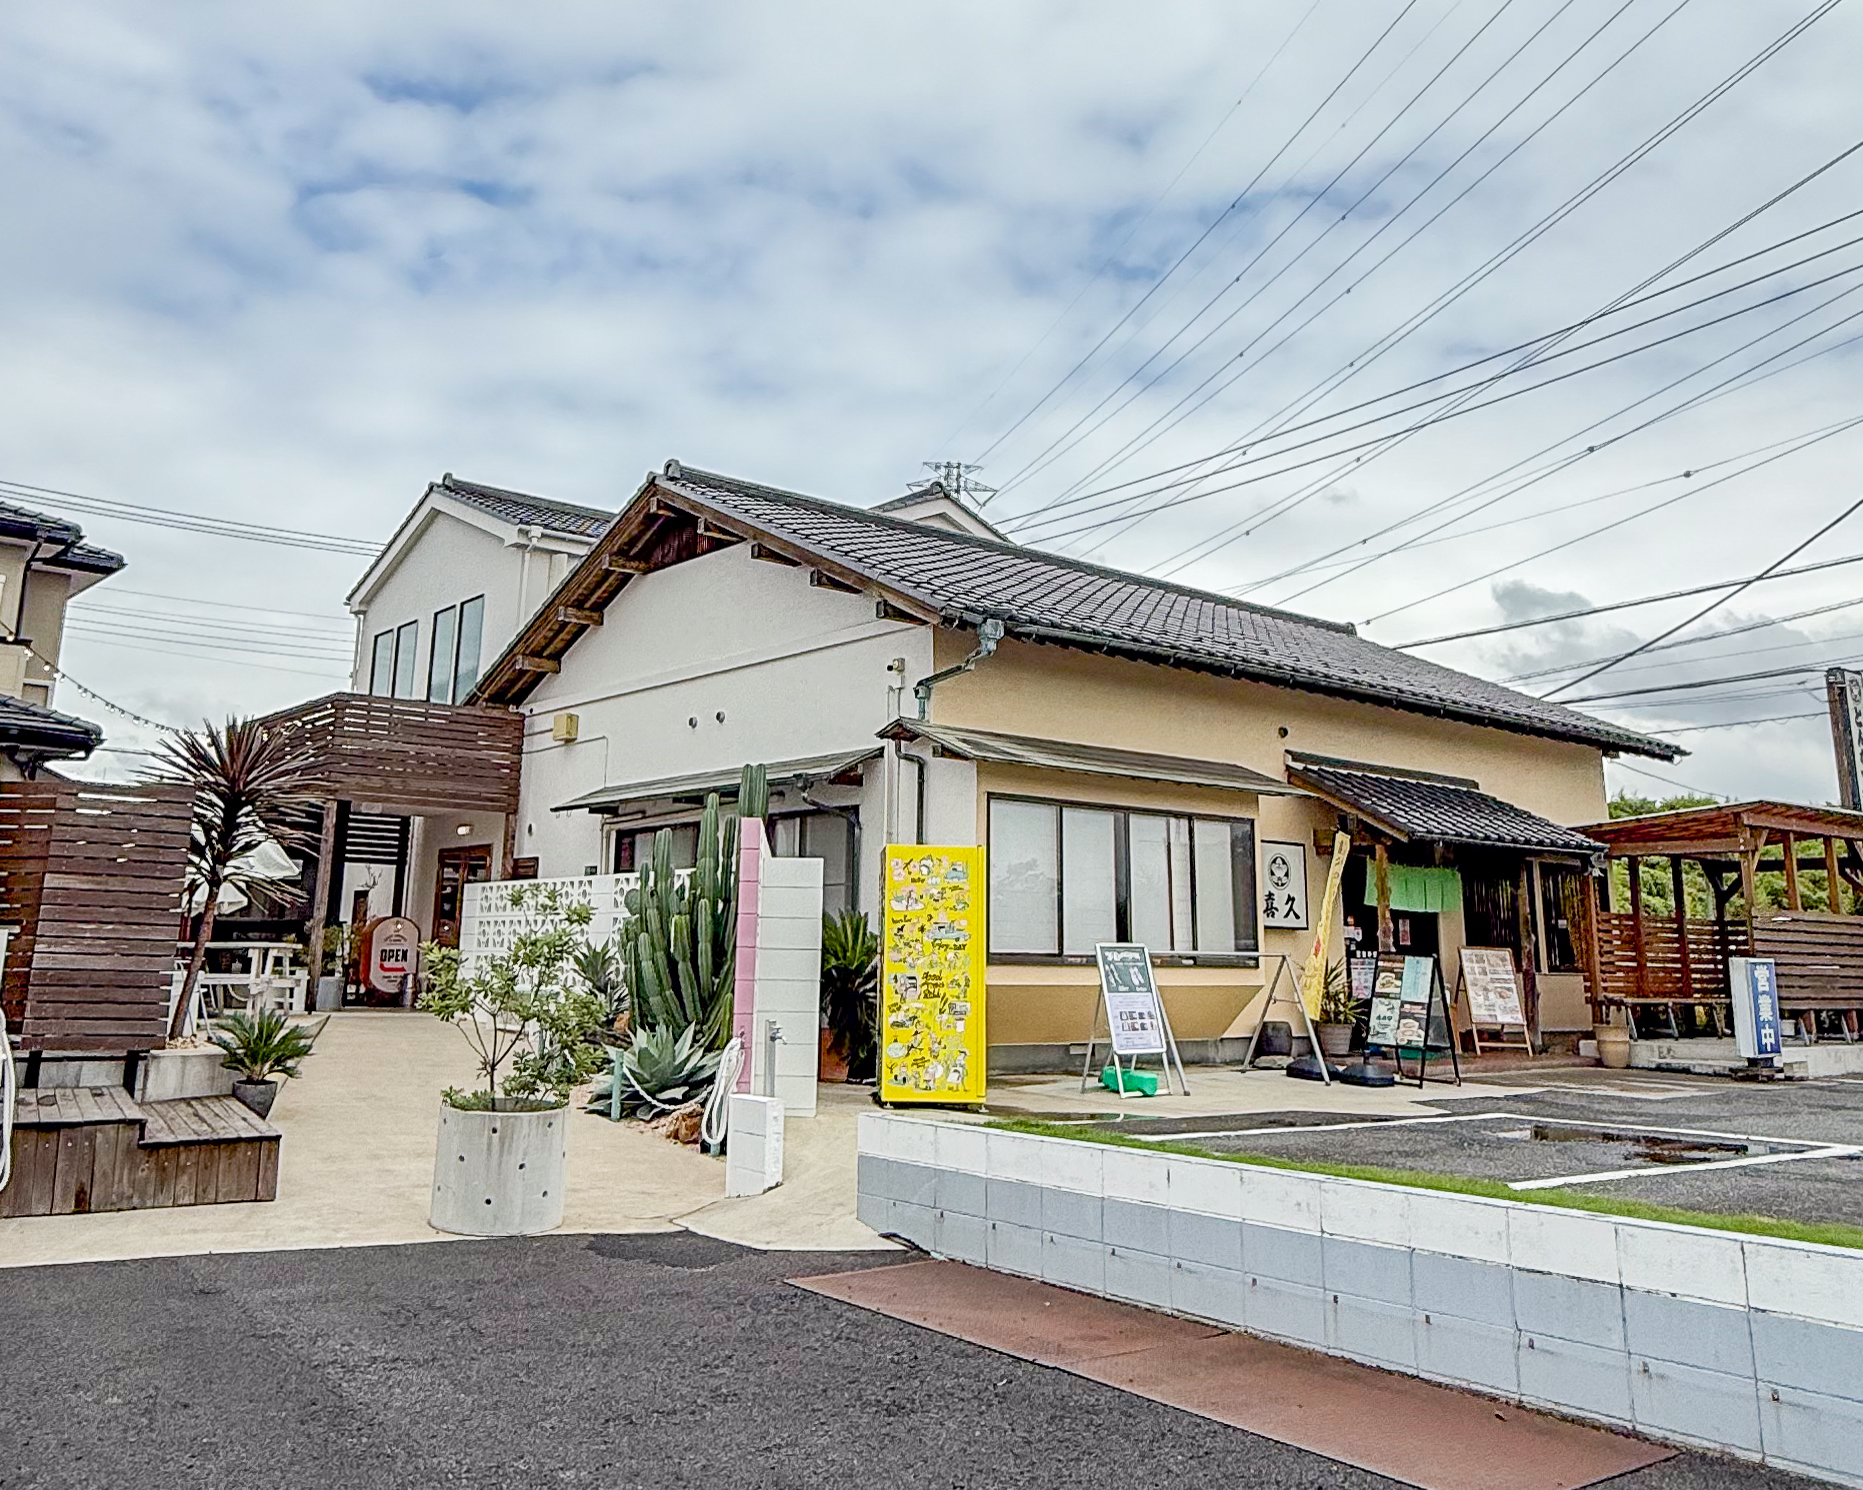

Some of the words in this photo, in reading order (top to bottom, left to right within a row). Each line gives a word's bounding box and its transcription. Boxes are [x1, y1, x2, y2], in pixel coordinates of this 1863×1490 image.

[1263, 891, 1301, 920] 喜久
[380, 948, 408, 962] OPEN
[1754, 964, 1776, 1052] 営業中
